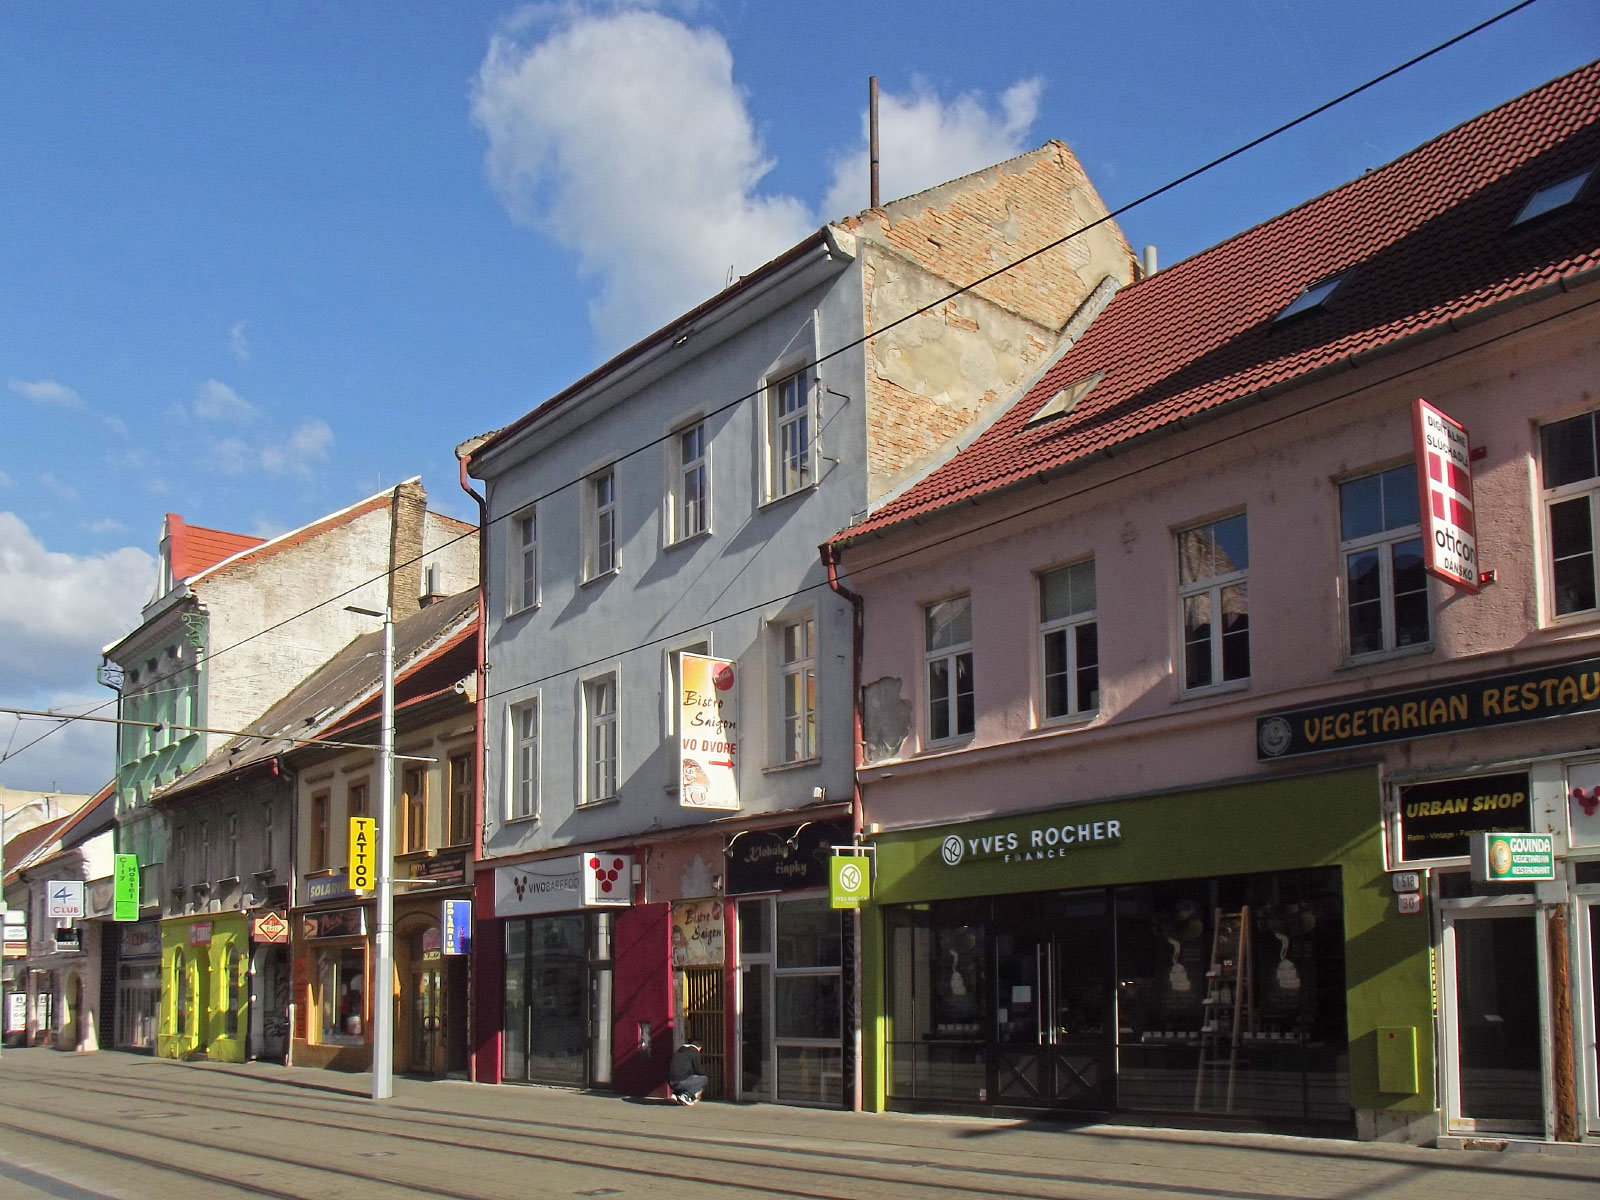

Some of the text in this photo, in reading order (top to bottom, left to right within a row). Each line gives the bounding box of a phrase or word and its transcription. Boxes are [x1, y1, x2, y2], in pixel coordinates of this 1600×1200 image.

[683, 690, 723, 709] Bistro
[1304, 671, 1600, 744] VEGETARIAN RESTAU
[690, 711, 737, 735] Saigon
[682, 738, 737, 755] VO DVORE
[1406, 792, 1525, 818] URBAN SHOP
[968, 820, 1121, 855] YVES ROCHER
[1510, 838, 1551, 853] GOVINDA
[356, 820, 367, 887] TATTOO
[1005, 848, 1067, 863] FRANCE
[1513, 854, 1550, 863] VEGETARIAN
[1512, 866, 1551, 875] RESTAURANT
[128, 866, 136, 899] Hostel
[310, 881, 349, 897] SOLARIU
[529, 877, 580, 893] VIVOBAREFOO
[1403, 897, 1415, 909] 30
